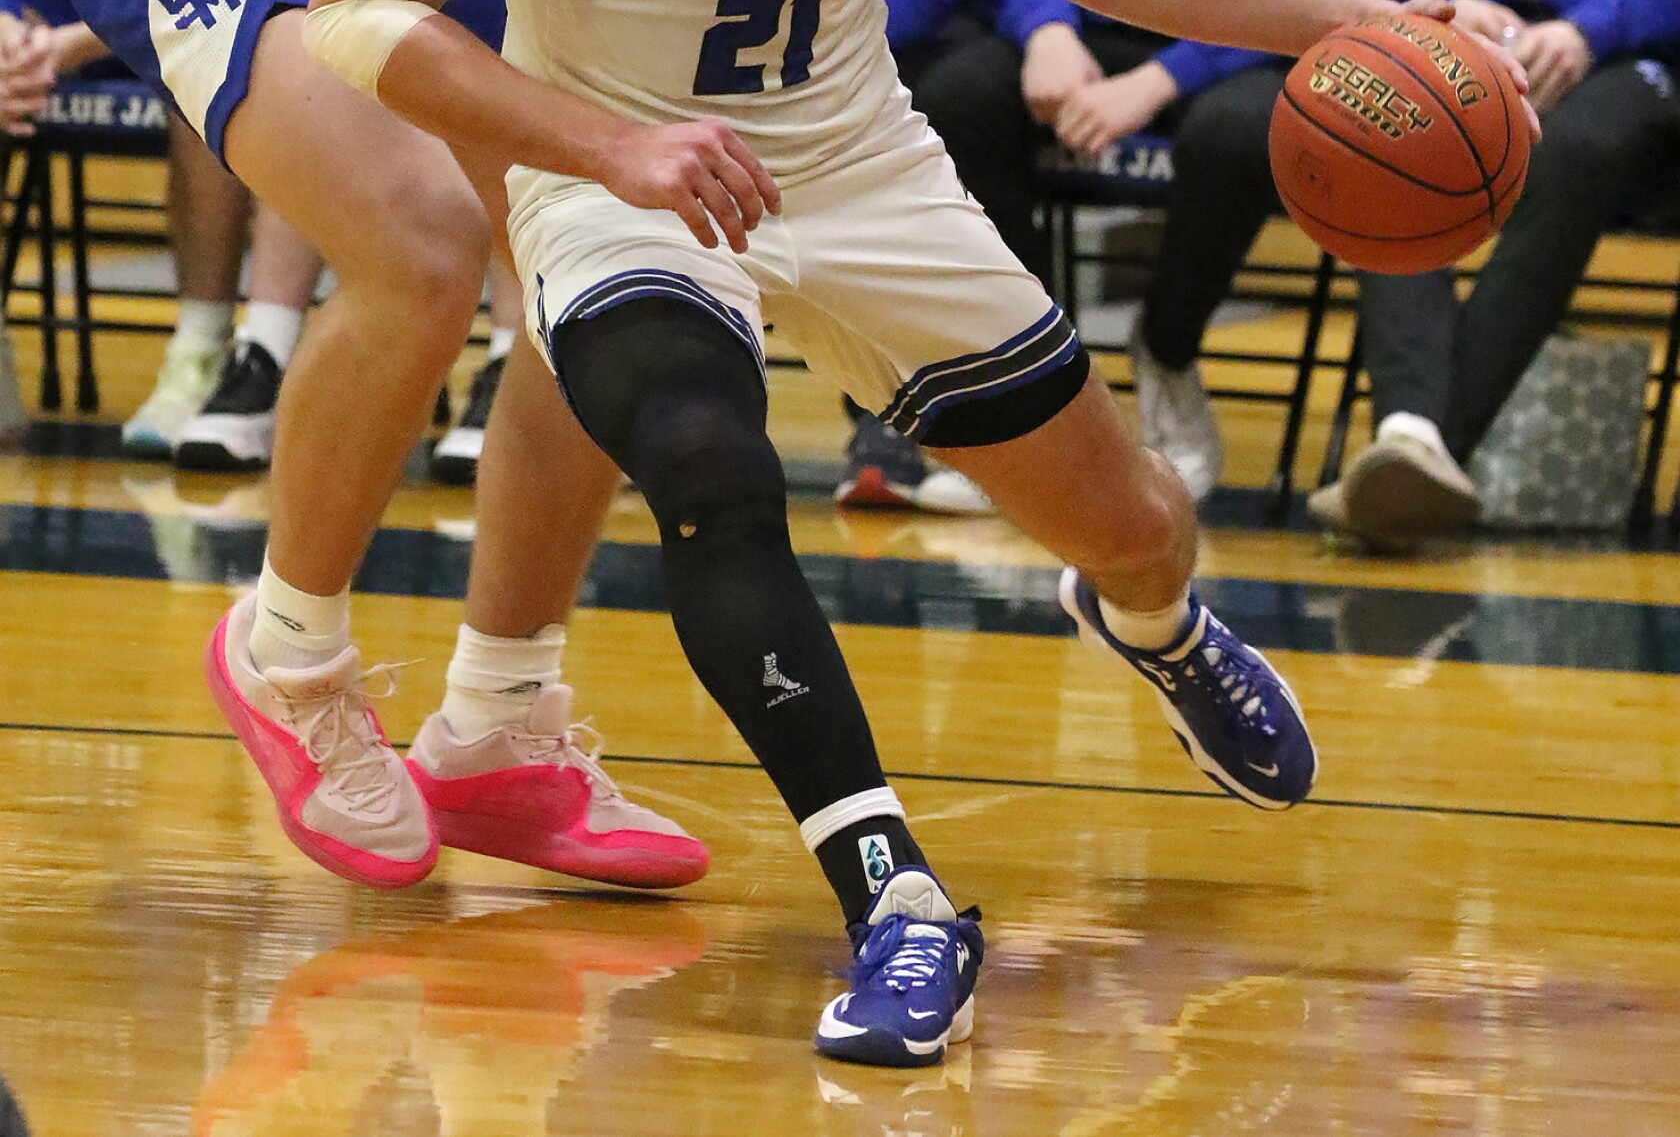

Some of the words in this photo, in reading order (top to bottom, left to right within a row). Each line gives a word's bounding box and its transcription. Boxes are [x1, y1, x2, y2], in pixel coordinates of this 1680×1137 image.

[1357, 15, 1488, 110] ALDING
[37, 92, 113, 124] LUE
[120, 95, 168, 127] JA
[1314, 51, 1433, 133] LEGACY
[766, 686, 810, 709] MUELLER
